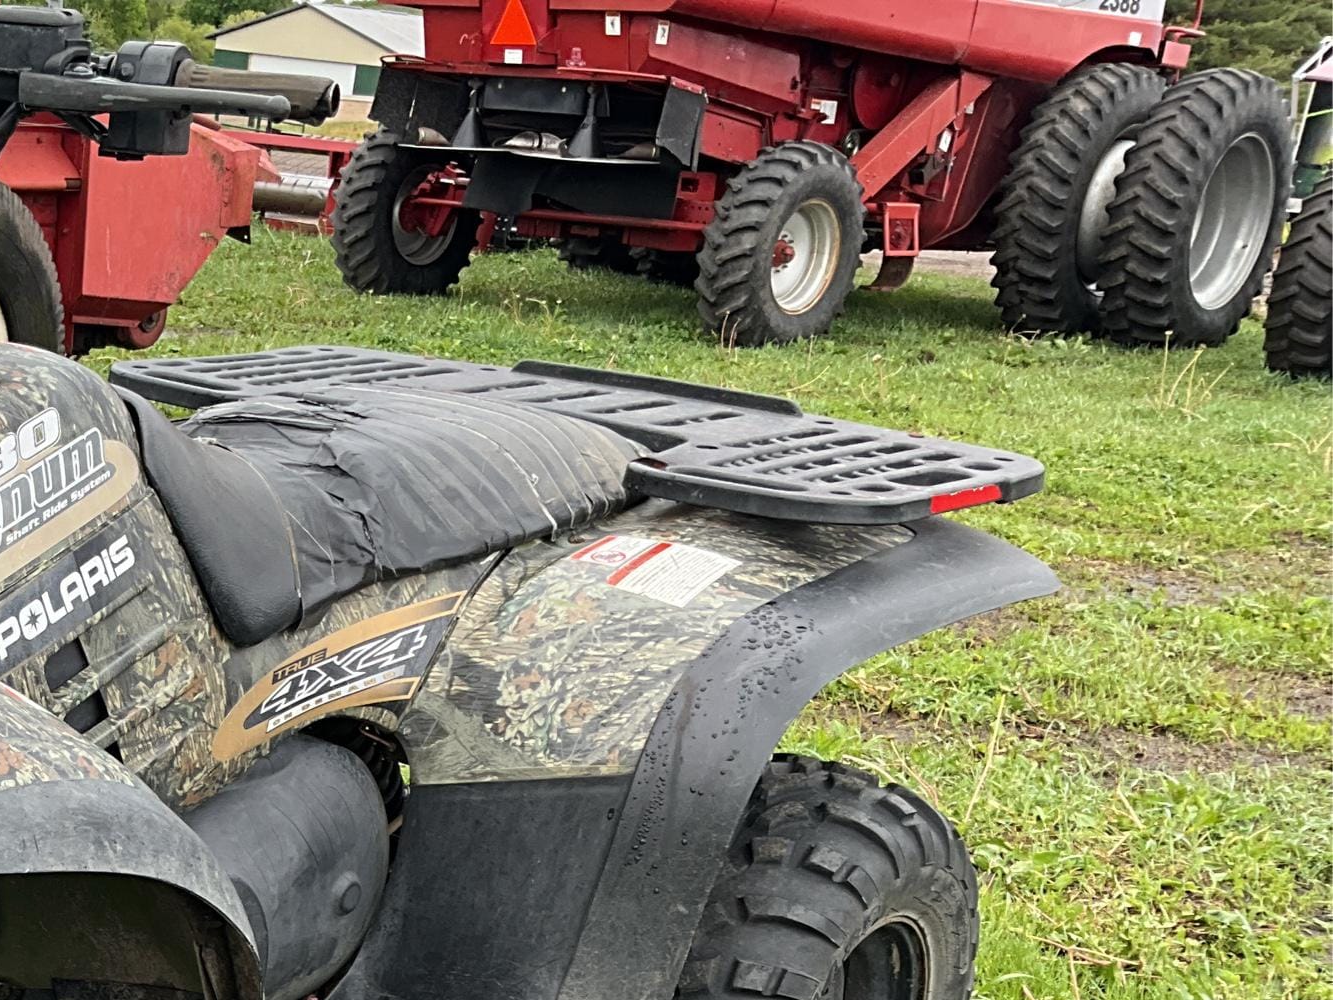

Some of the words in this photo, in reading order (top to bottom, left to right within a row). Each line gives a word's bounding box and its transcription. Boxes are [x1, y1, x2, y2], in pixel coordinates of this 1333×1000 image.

[5, 516, 41, 545] Shaft
[43, 498, 67, 520] Ride
[70, 470, 111, 502] System
[260, 624, 428, 714] 4X4
[274, 651, 326, 682] TRUE
